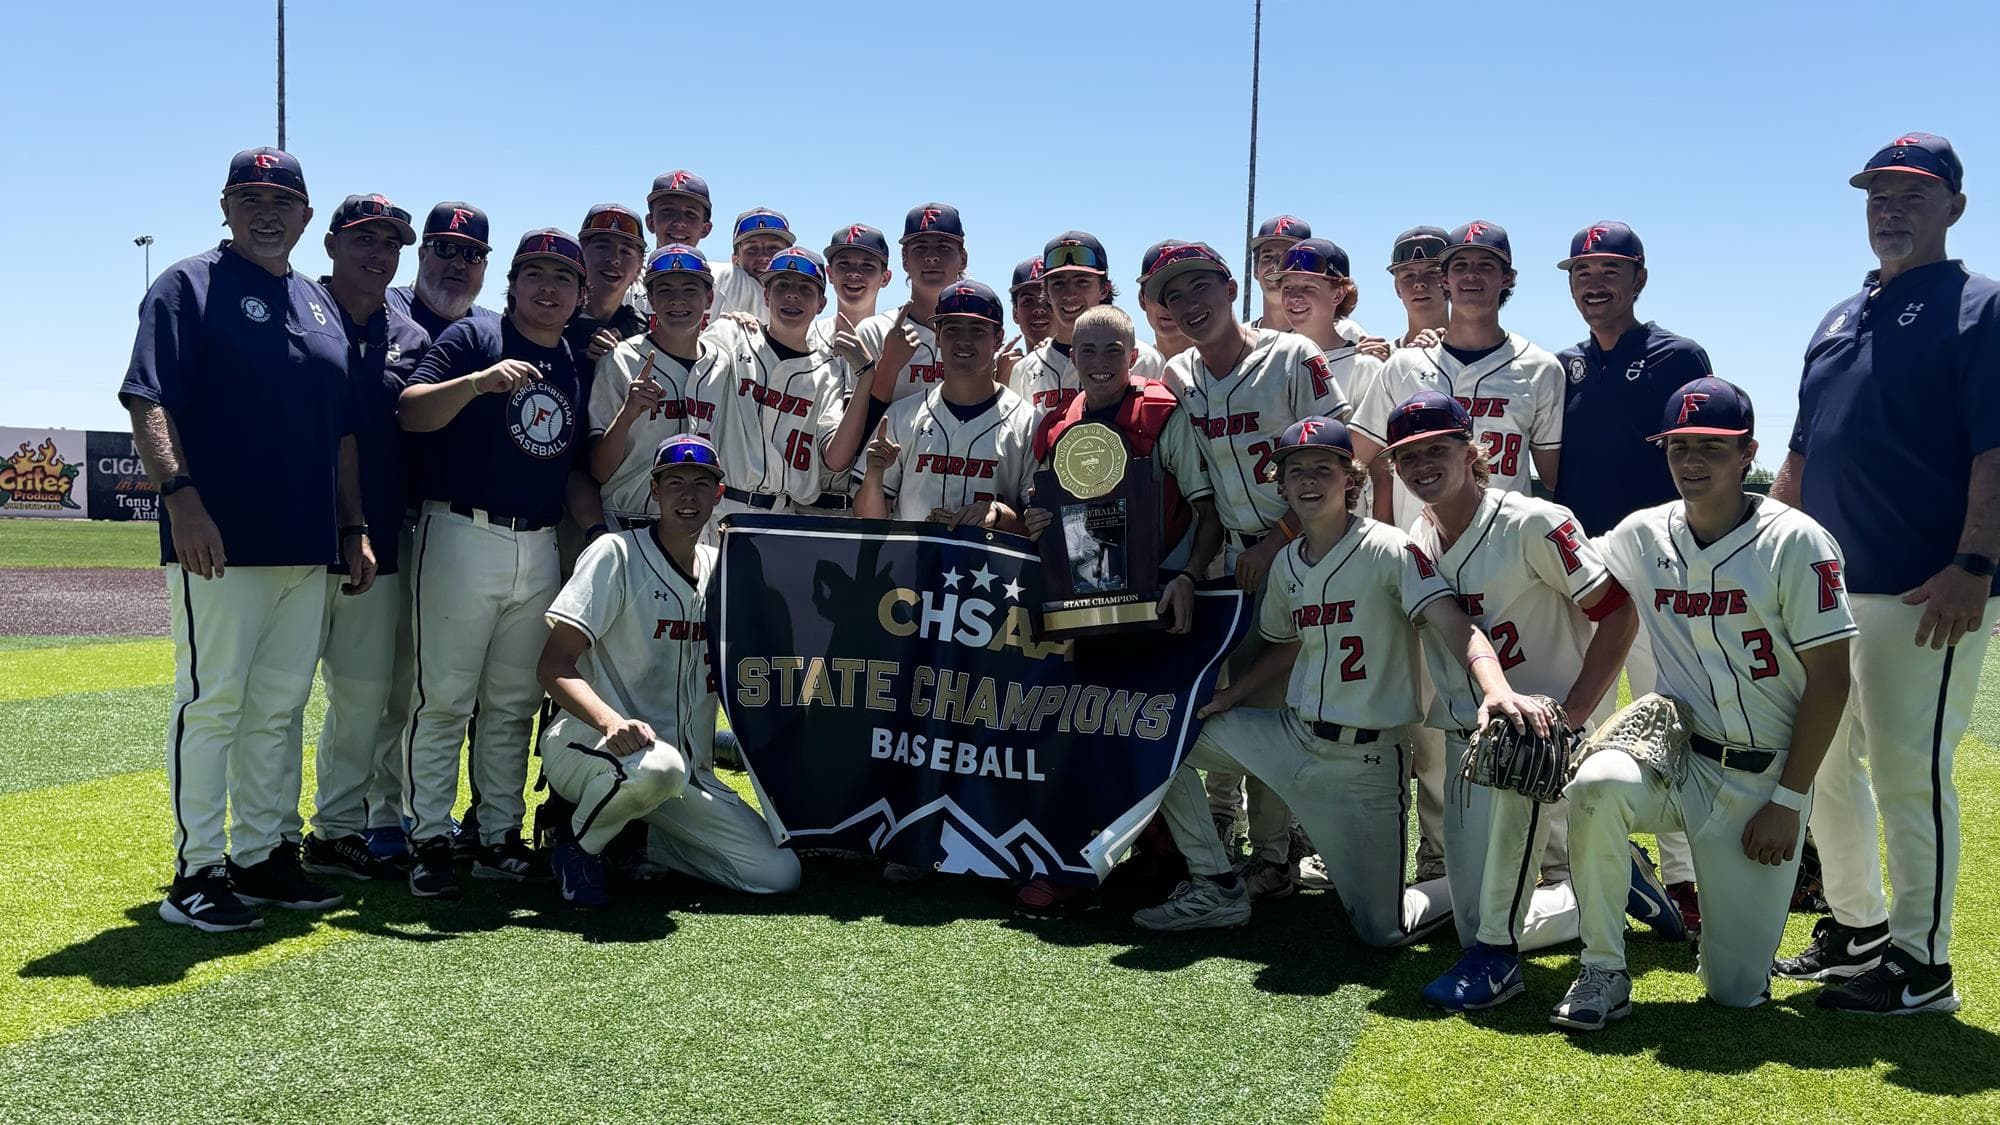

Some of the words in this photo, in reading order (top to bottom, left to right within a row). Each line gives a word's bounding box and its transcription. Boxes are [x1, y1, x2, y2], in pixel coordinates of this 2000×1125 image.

[670, 171, 692, 190] F
[450, 208, 474, 230] F
[919, 209, 942, 231] F
[1274, 218, 1296, 235] F
[845, 225, 867, 244] F
[1464, 223, 1488, 243] F
[1583, 227, 1609, 251] F
[910, 361, 944, 383] FOR
[1301, 355, 1333, 400] F
[537, 383, 572, 425] CHRISTIAN
[738, 378, 814, 417] FORGE
[1032, 388, 1079, 409] FOR
[1677, 393, 1710, 424] F
[532, 407, 551, 426] F
[510, 423, 567, 456] BASEBALL
[1297, 421, 1325, 444] F
[784, 428, 814, 471] 16
[1248, 437, 1281, 484] 2
[1480, 431, 1523, 477] 28
[98, 458, 147, 475] CIGA
[915, 454, 999, 478] FORGE
[0, 466, 71, 493] Crites
[14, 491, 61, 501] Produce
[116, 494, 152, 511] Tony
[132, 508, 160, 520] And
[1545, 519, 1583, 576] F
[1810, 559, 1844, 613] F
[1063, 600, 1090, 609] STATE
[1091, 594, 1139, 606] CHAMPION
[1655, 588, 1747, 618] FORGE
[653, 619, 708, 642] FOR
[1482, 620, 1516, 671] 2
[1742, 628, 1780, 681] 3
[1340, 636, 1367, 682] 2
[737, 656, 900, 711] STATE
[911, 666, 1177, 741] CHAMPIONS
[871, 727, 1045, 782] BASEBALL
[1884, 961, 1905, 976] NIKE
